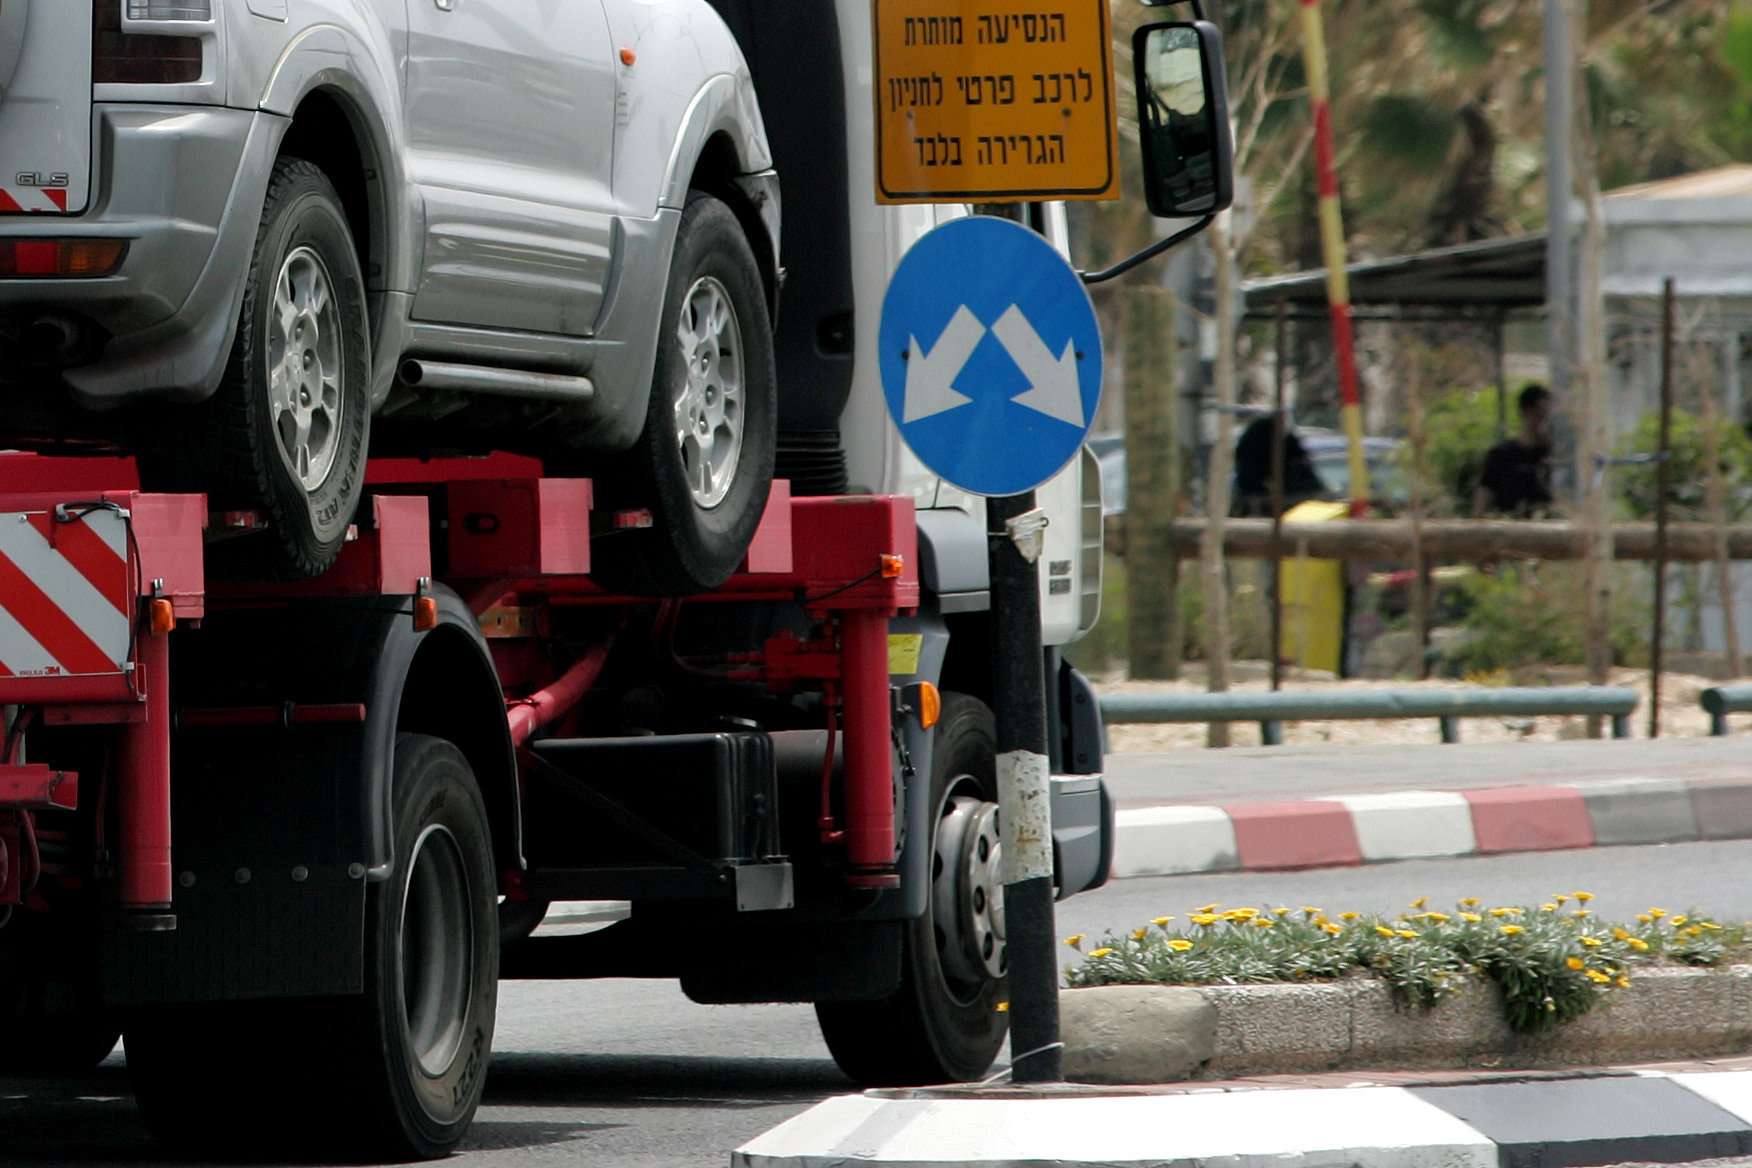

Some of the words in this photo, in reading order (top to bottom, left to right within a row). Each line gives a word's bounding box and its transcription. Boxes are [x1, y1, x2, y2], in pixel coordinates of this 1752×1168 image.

[904, 16, 963, 46] מותרת
[977, 13, 1066, 45] הנסיעה
[888, 71, 943, 112] לחניון
[956, 74, 1015, 105] פרטי
[1032, 68, 1093, 104] לרכב
[914, 132, 963, 167] בלבד
[977, 134, 1065, 165] הגרירה
[16, 172, 69, 187] GLS
